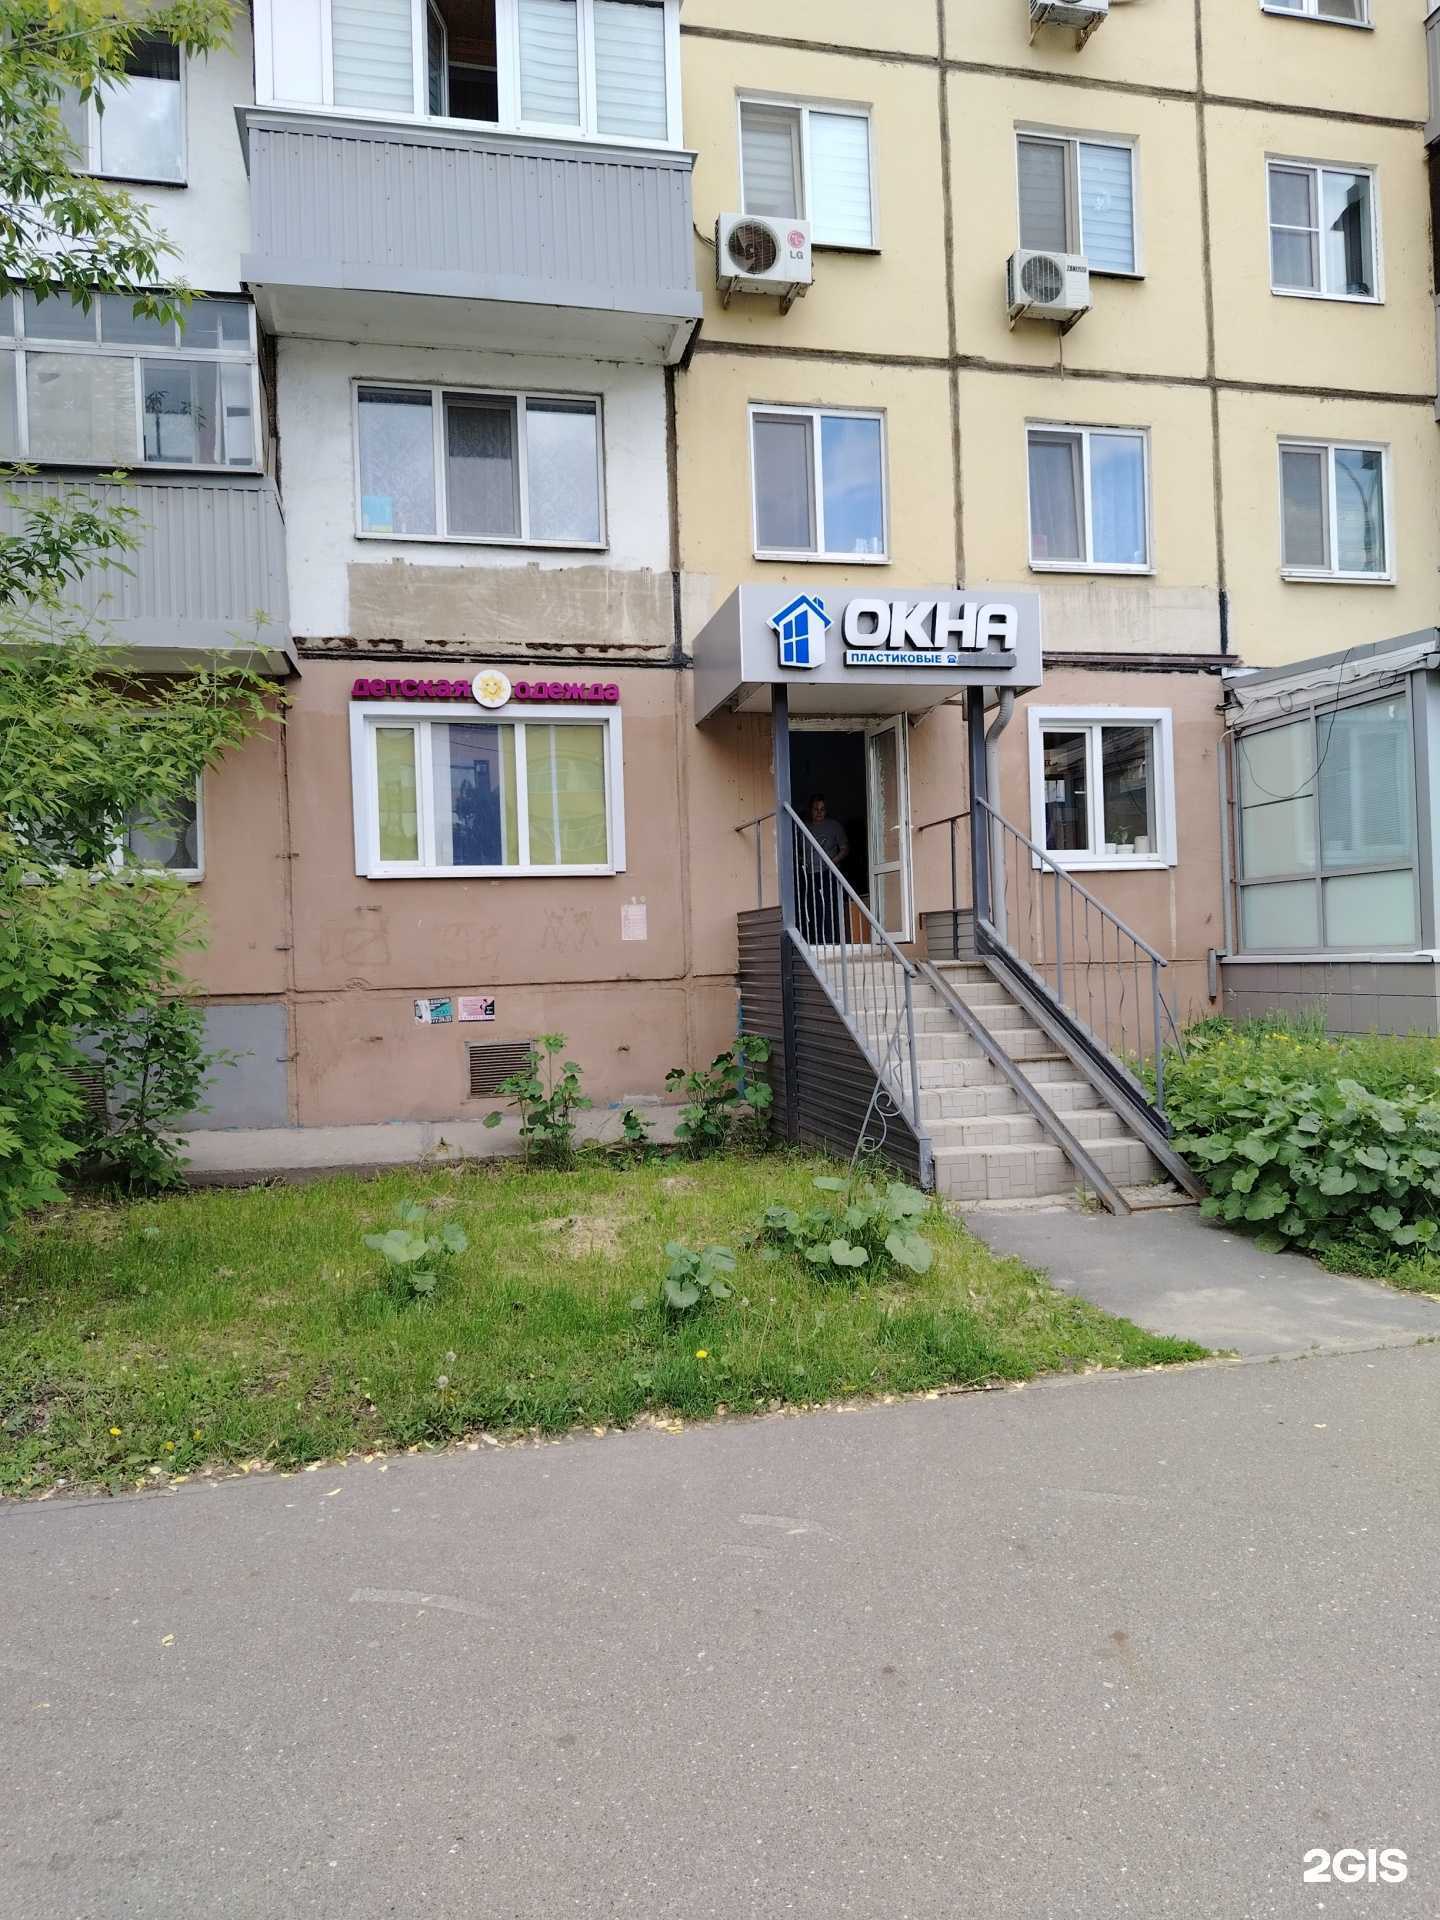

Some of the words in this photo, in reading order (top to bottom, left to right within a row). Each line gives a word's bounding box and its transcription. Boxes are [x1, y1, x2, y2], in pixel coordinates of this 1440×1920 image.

[789, 250, 804, 260] LG
[843, 598, 1018, 651] ОКНА
[850, 652, 942, 665] ПЛАСТИКОВЫЕ
[352, 678, 471, 698] детская
[515, 682, 620, 702] одежда
